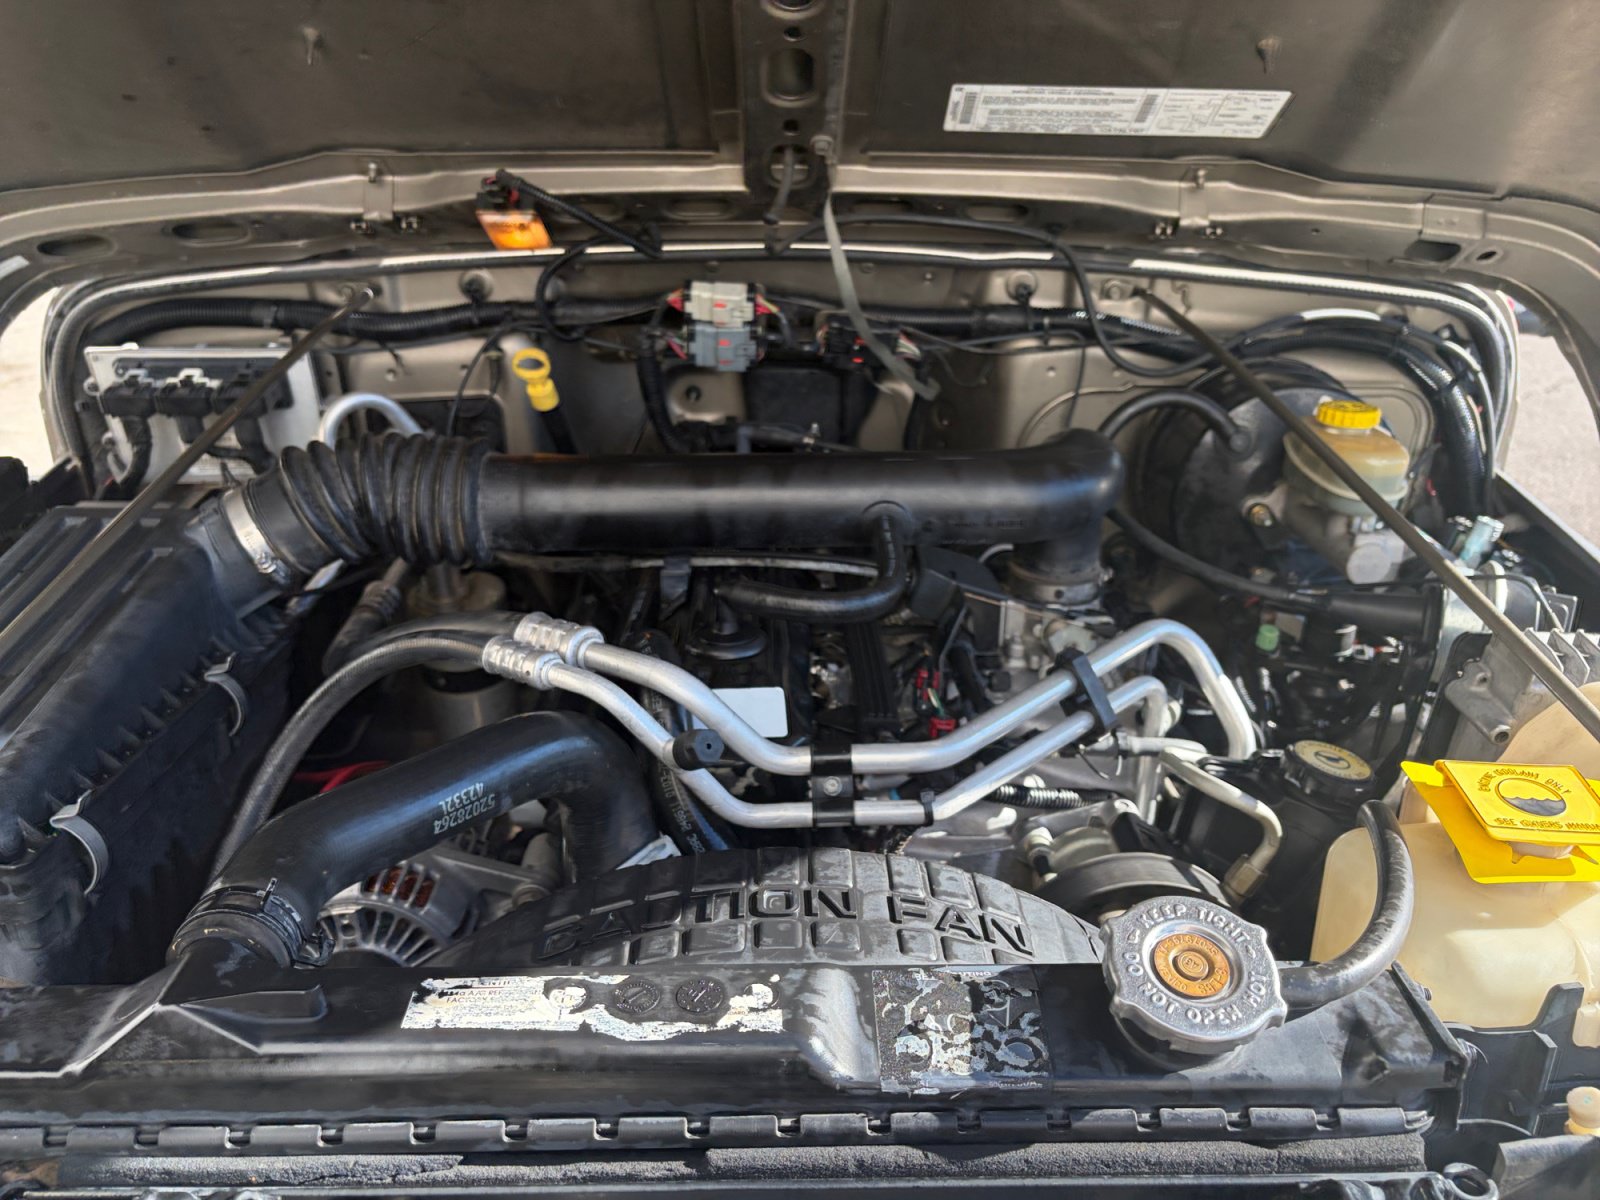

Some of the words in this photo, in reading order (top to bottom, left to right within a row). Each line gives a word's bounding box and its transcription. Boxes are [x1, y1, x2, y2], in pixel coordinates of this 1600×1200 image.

[1544, 778, 1572, 795] ONLY
[890, 892, 1034, 957] FAN
[1139, 903, 1187, 929] KEEP
[1196, 906, 1251, 945] TIGHT
[1139, 982, 1182, 1014] NOT
[1185, 1003, 1243, 1026] OPEN
[1243, 971, 1268, 1008] HOT
